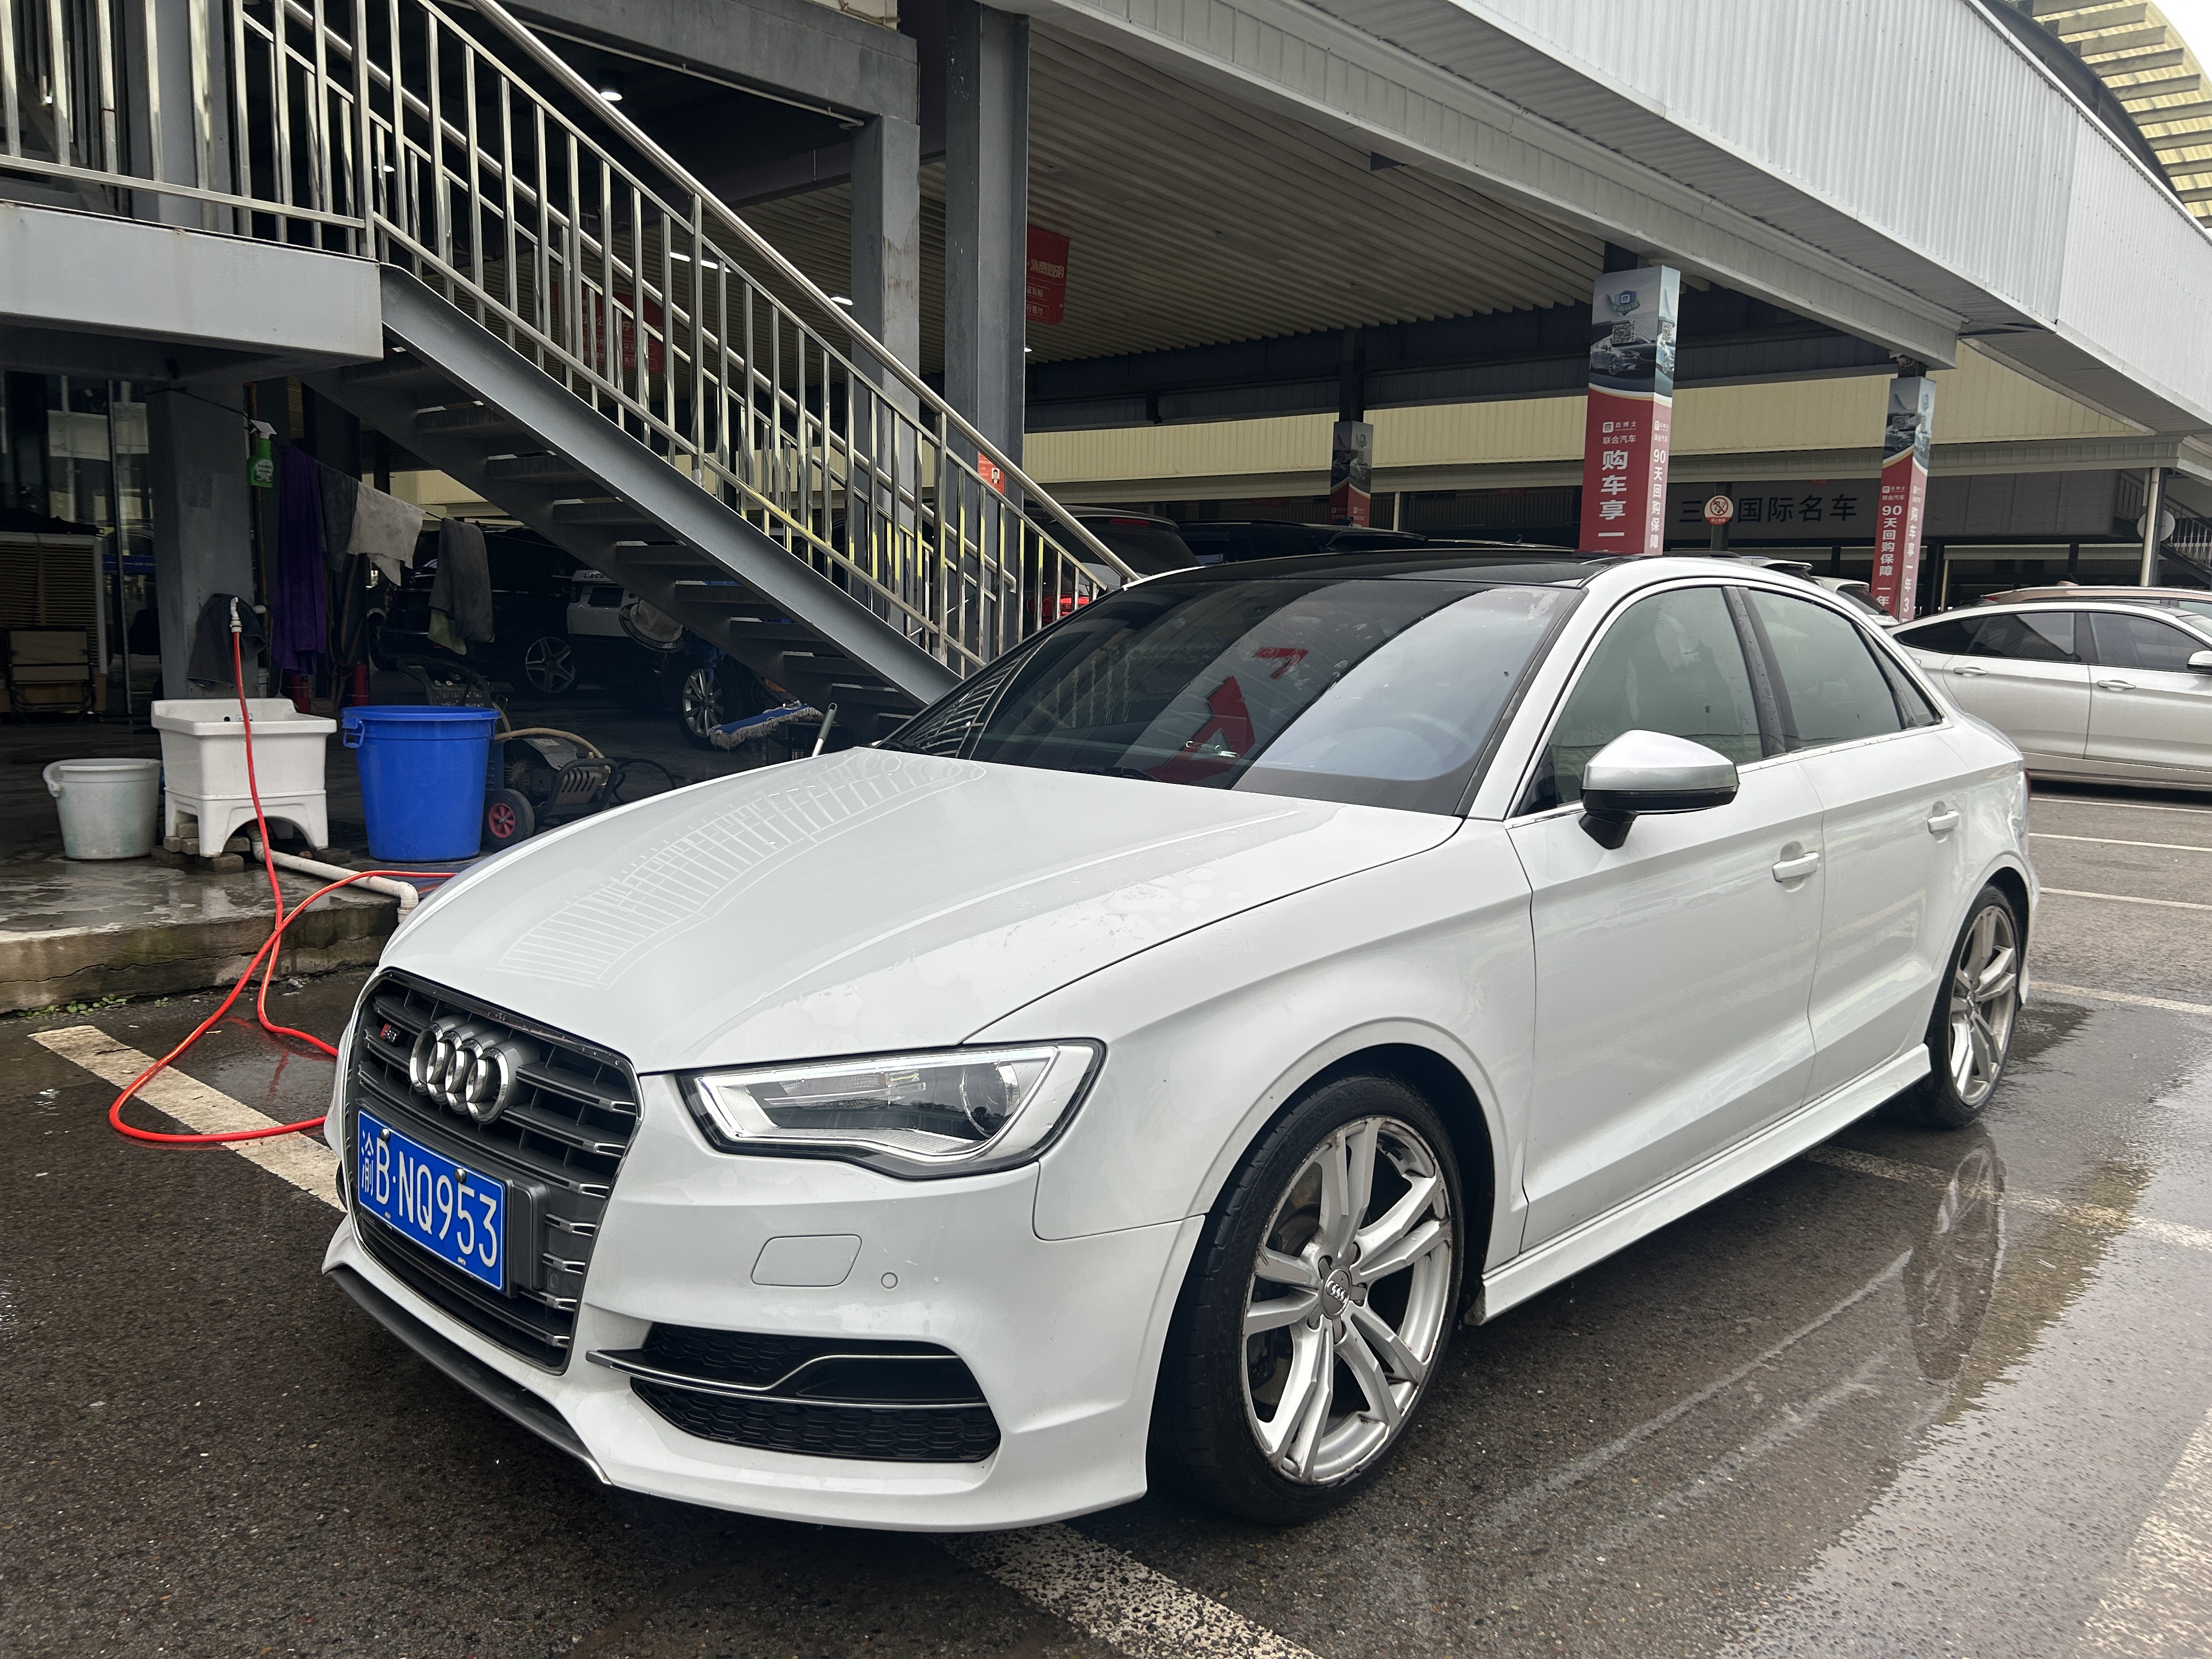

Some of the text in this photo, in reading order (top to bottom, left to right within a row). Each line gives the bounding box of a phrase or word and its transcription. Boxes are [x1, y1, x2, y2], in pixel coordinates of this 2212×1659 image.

[1602, 435, 1637, 445] 联合汽车
[1598, 449, 1628, 551] 购车享一
[1650, 449, 1666, 549] 90天回购保障
[1681, 494, 1858, 522] 三国际名车
